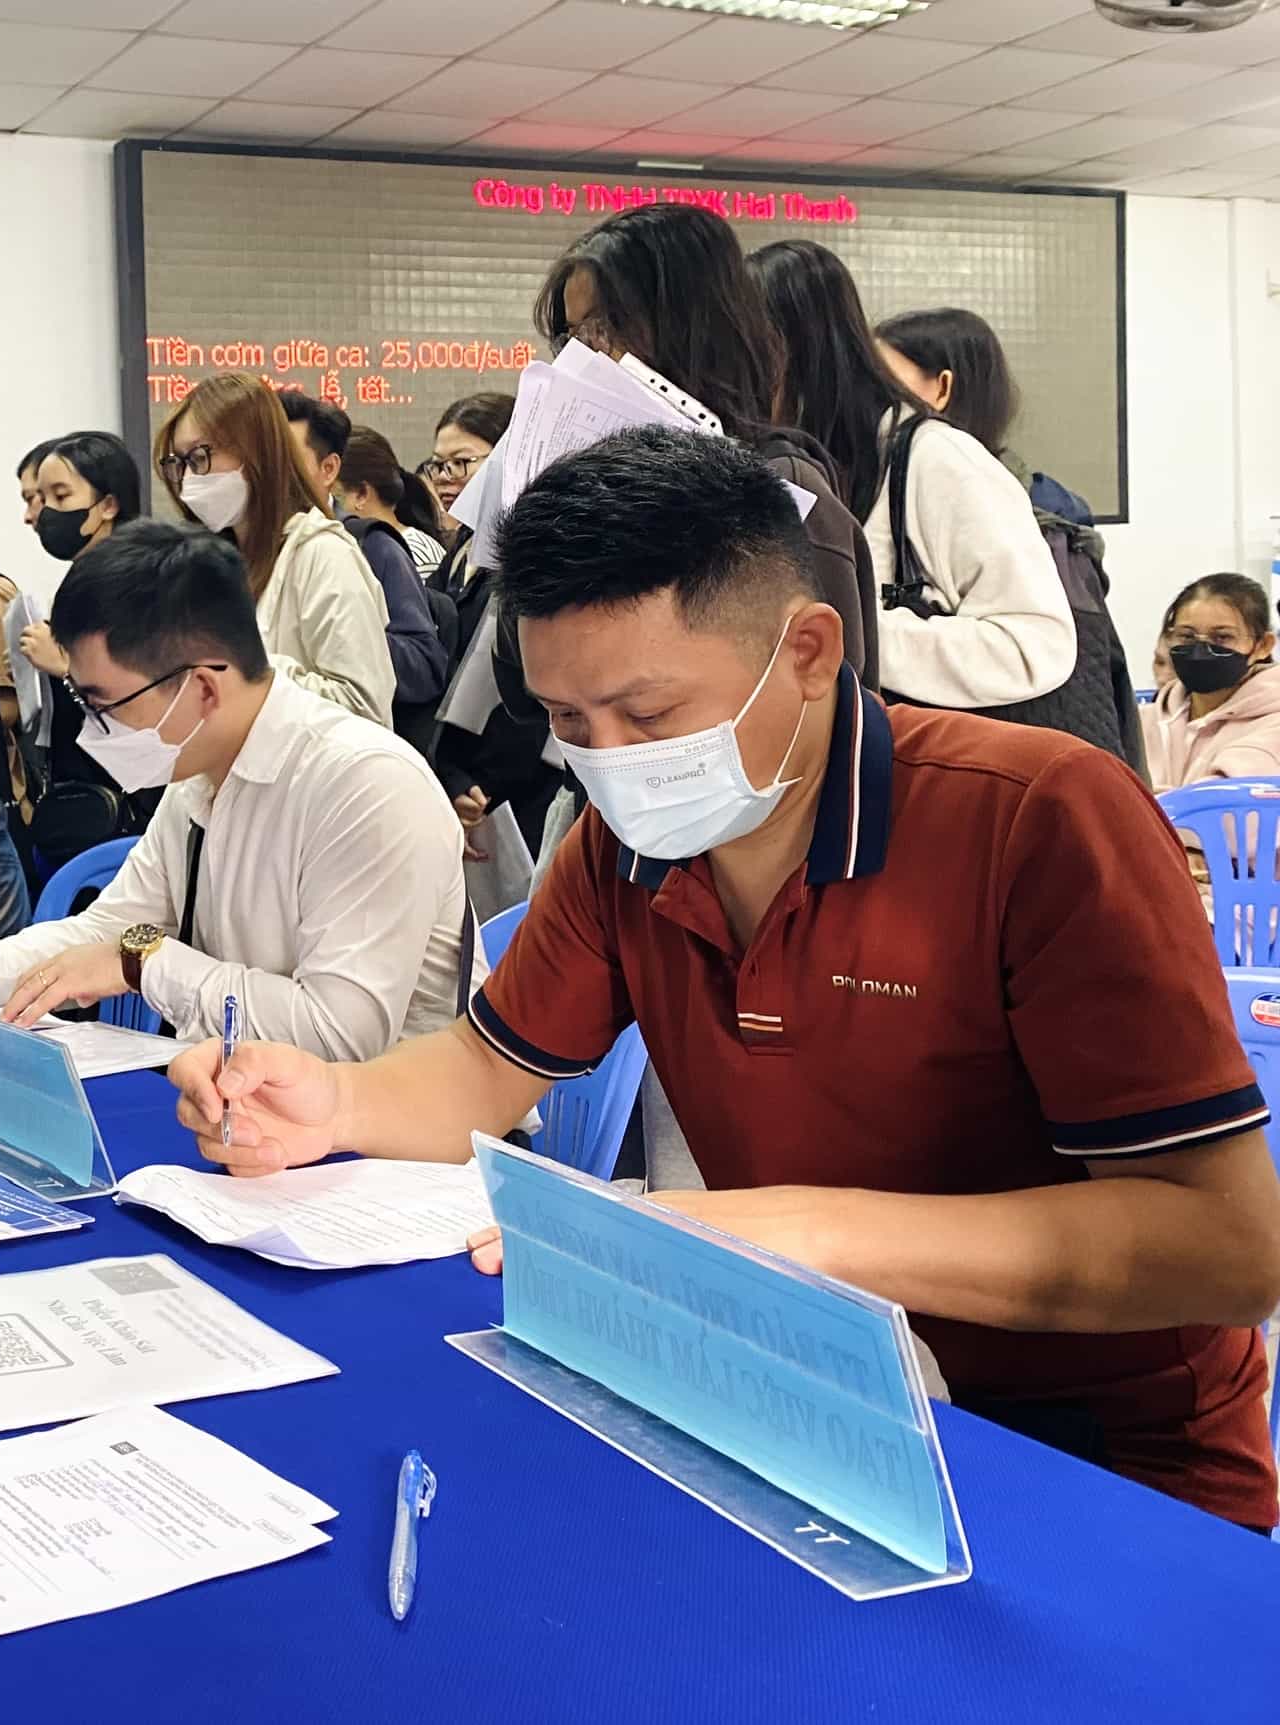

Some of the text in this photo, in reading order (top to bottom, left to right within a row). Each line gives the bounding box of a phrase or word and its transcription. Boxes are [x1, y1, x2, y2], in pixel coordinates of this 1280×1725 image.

[474, 179, 543, 214] Công
[549, 183, 576, 215] ty
[146, 337, 537, 374] Tiền cơm giữa ca: 25,000đ/suất
[147, 374, 198, 403] Tiề
